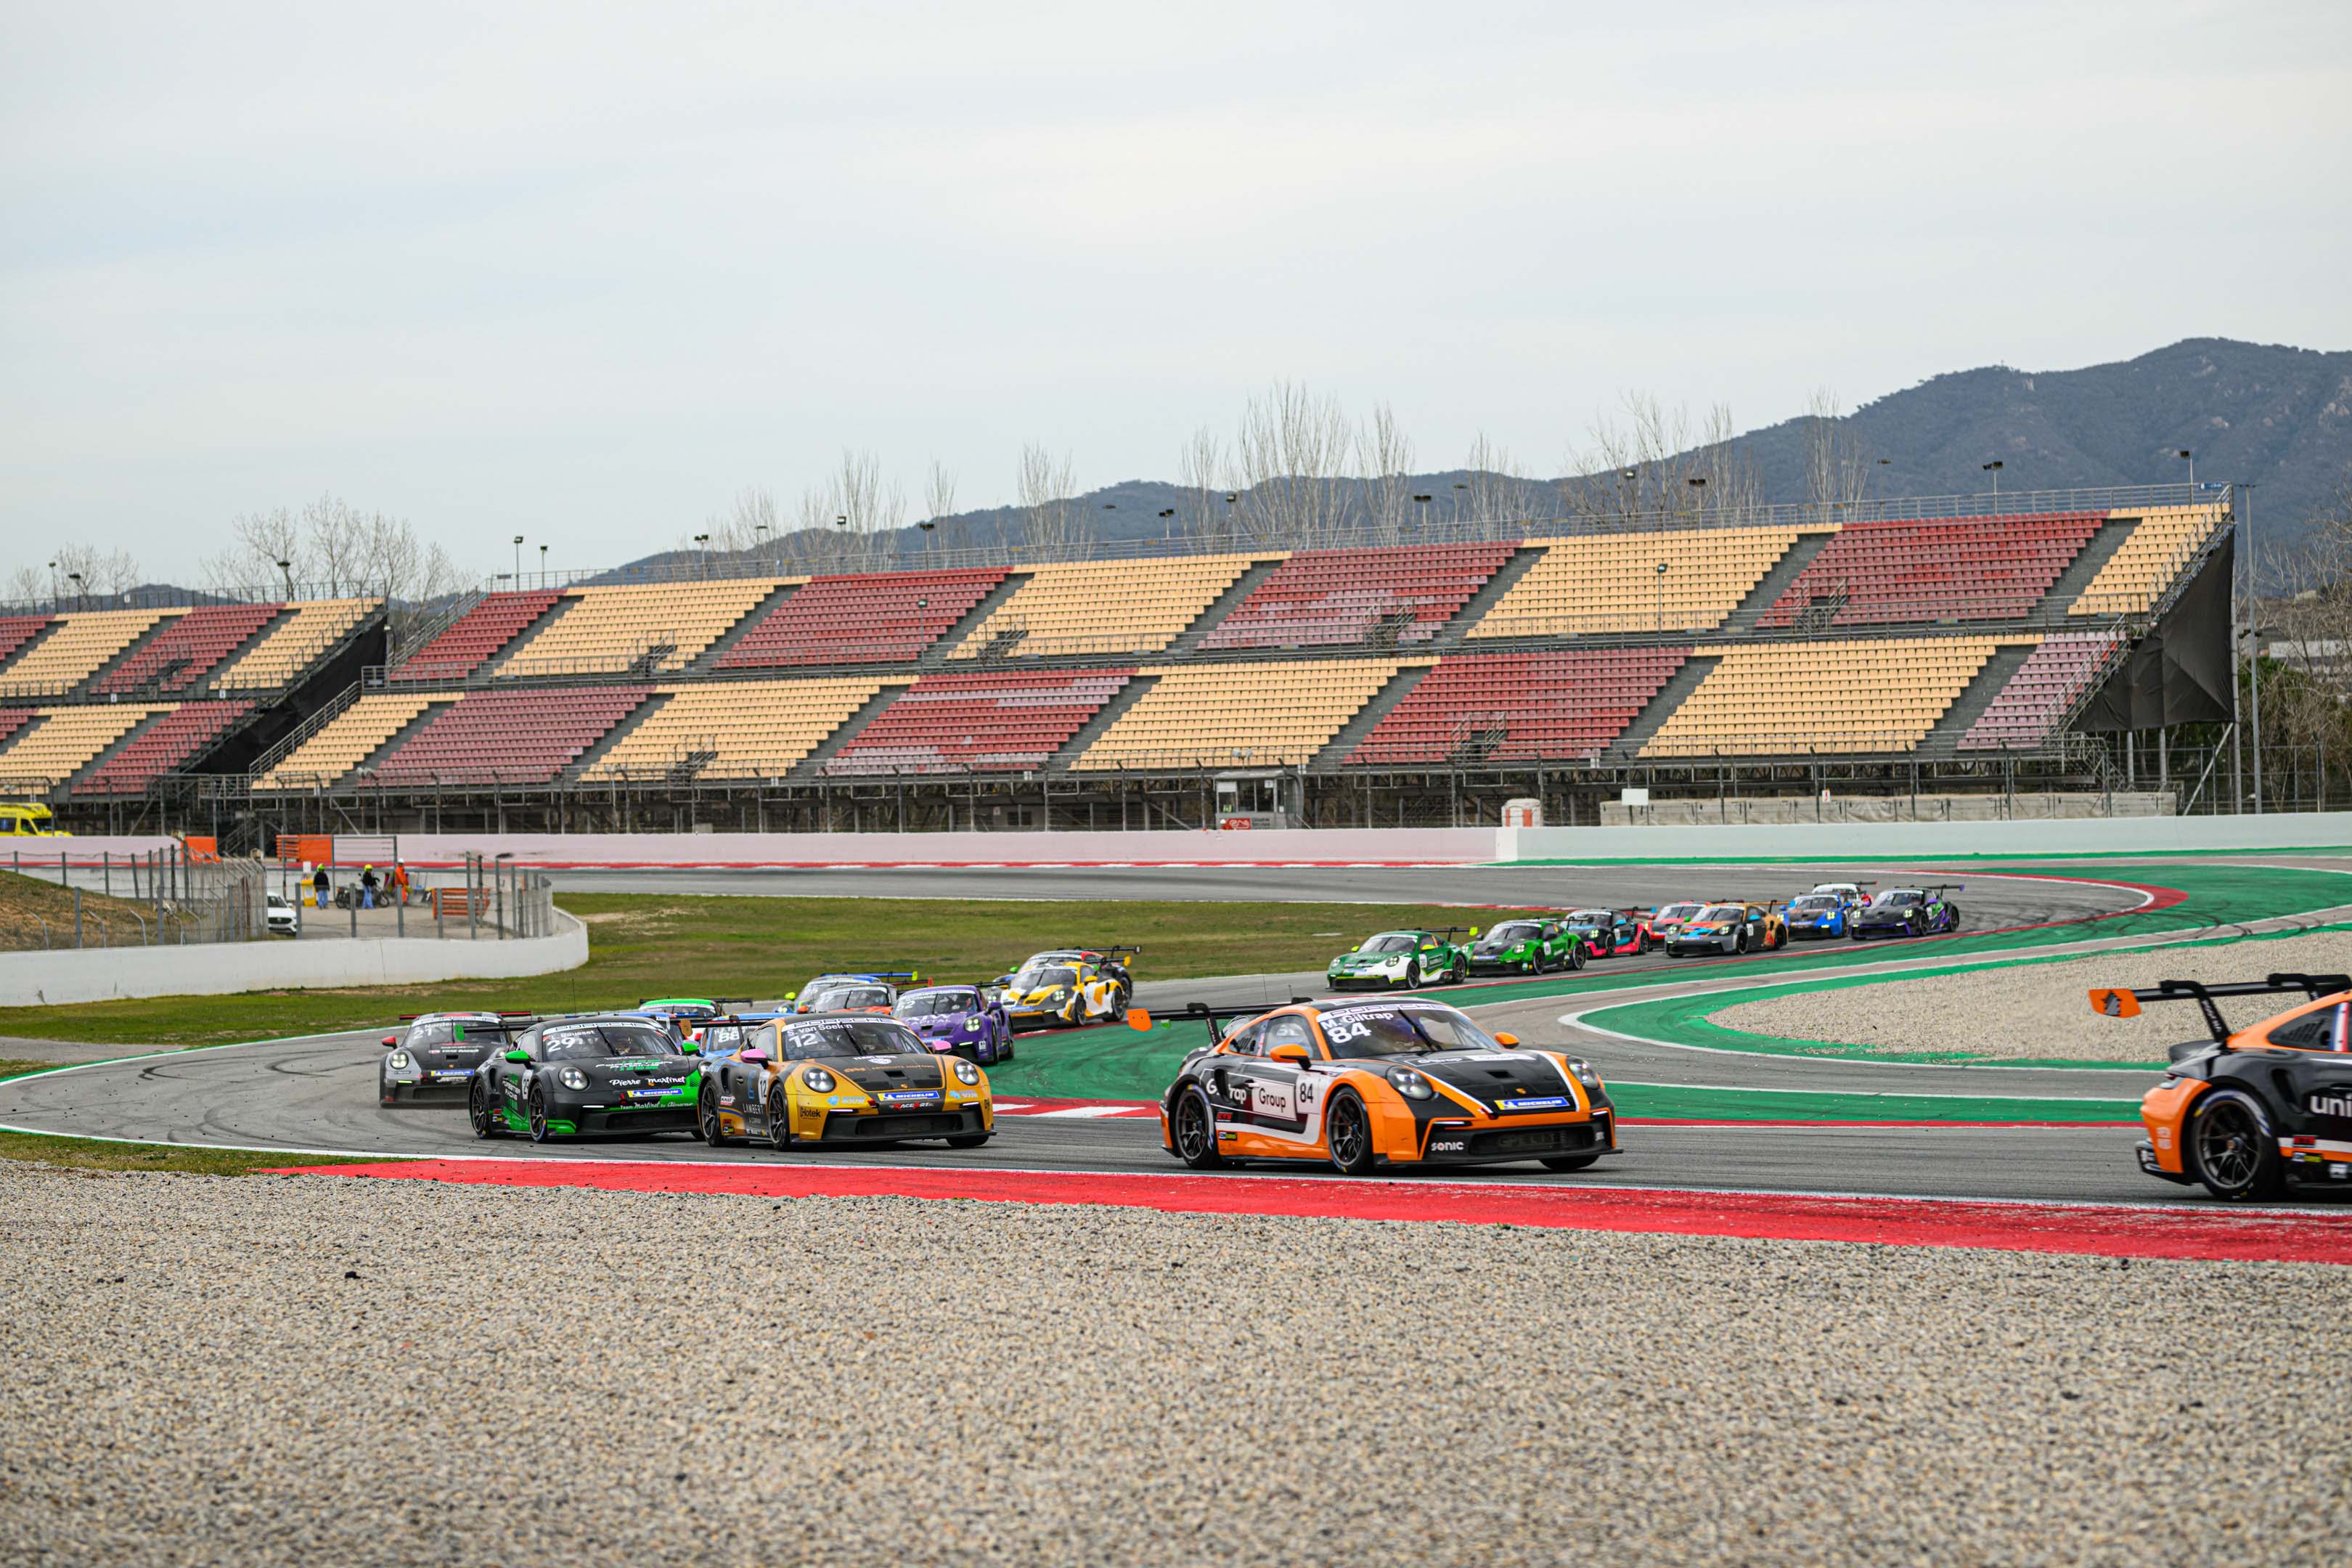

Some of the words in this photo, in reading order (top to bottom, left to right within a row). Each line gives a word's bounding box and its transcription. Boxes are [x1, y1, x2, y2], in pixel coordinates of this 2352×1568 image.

[1343, 1012, 1395, 1024] Giltrap
[789, 1033, 818, 1048] 12
[1327, 1021, 1372, 1044] 84
[547, 1037, 576, 1053] 29
[760, 1079, 767, 1098] 12
[1299, 1082, 1313, 1103] 84
[1259, 1087, 1286, 1113] Group
